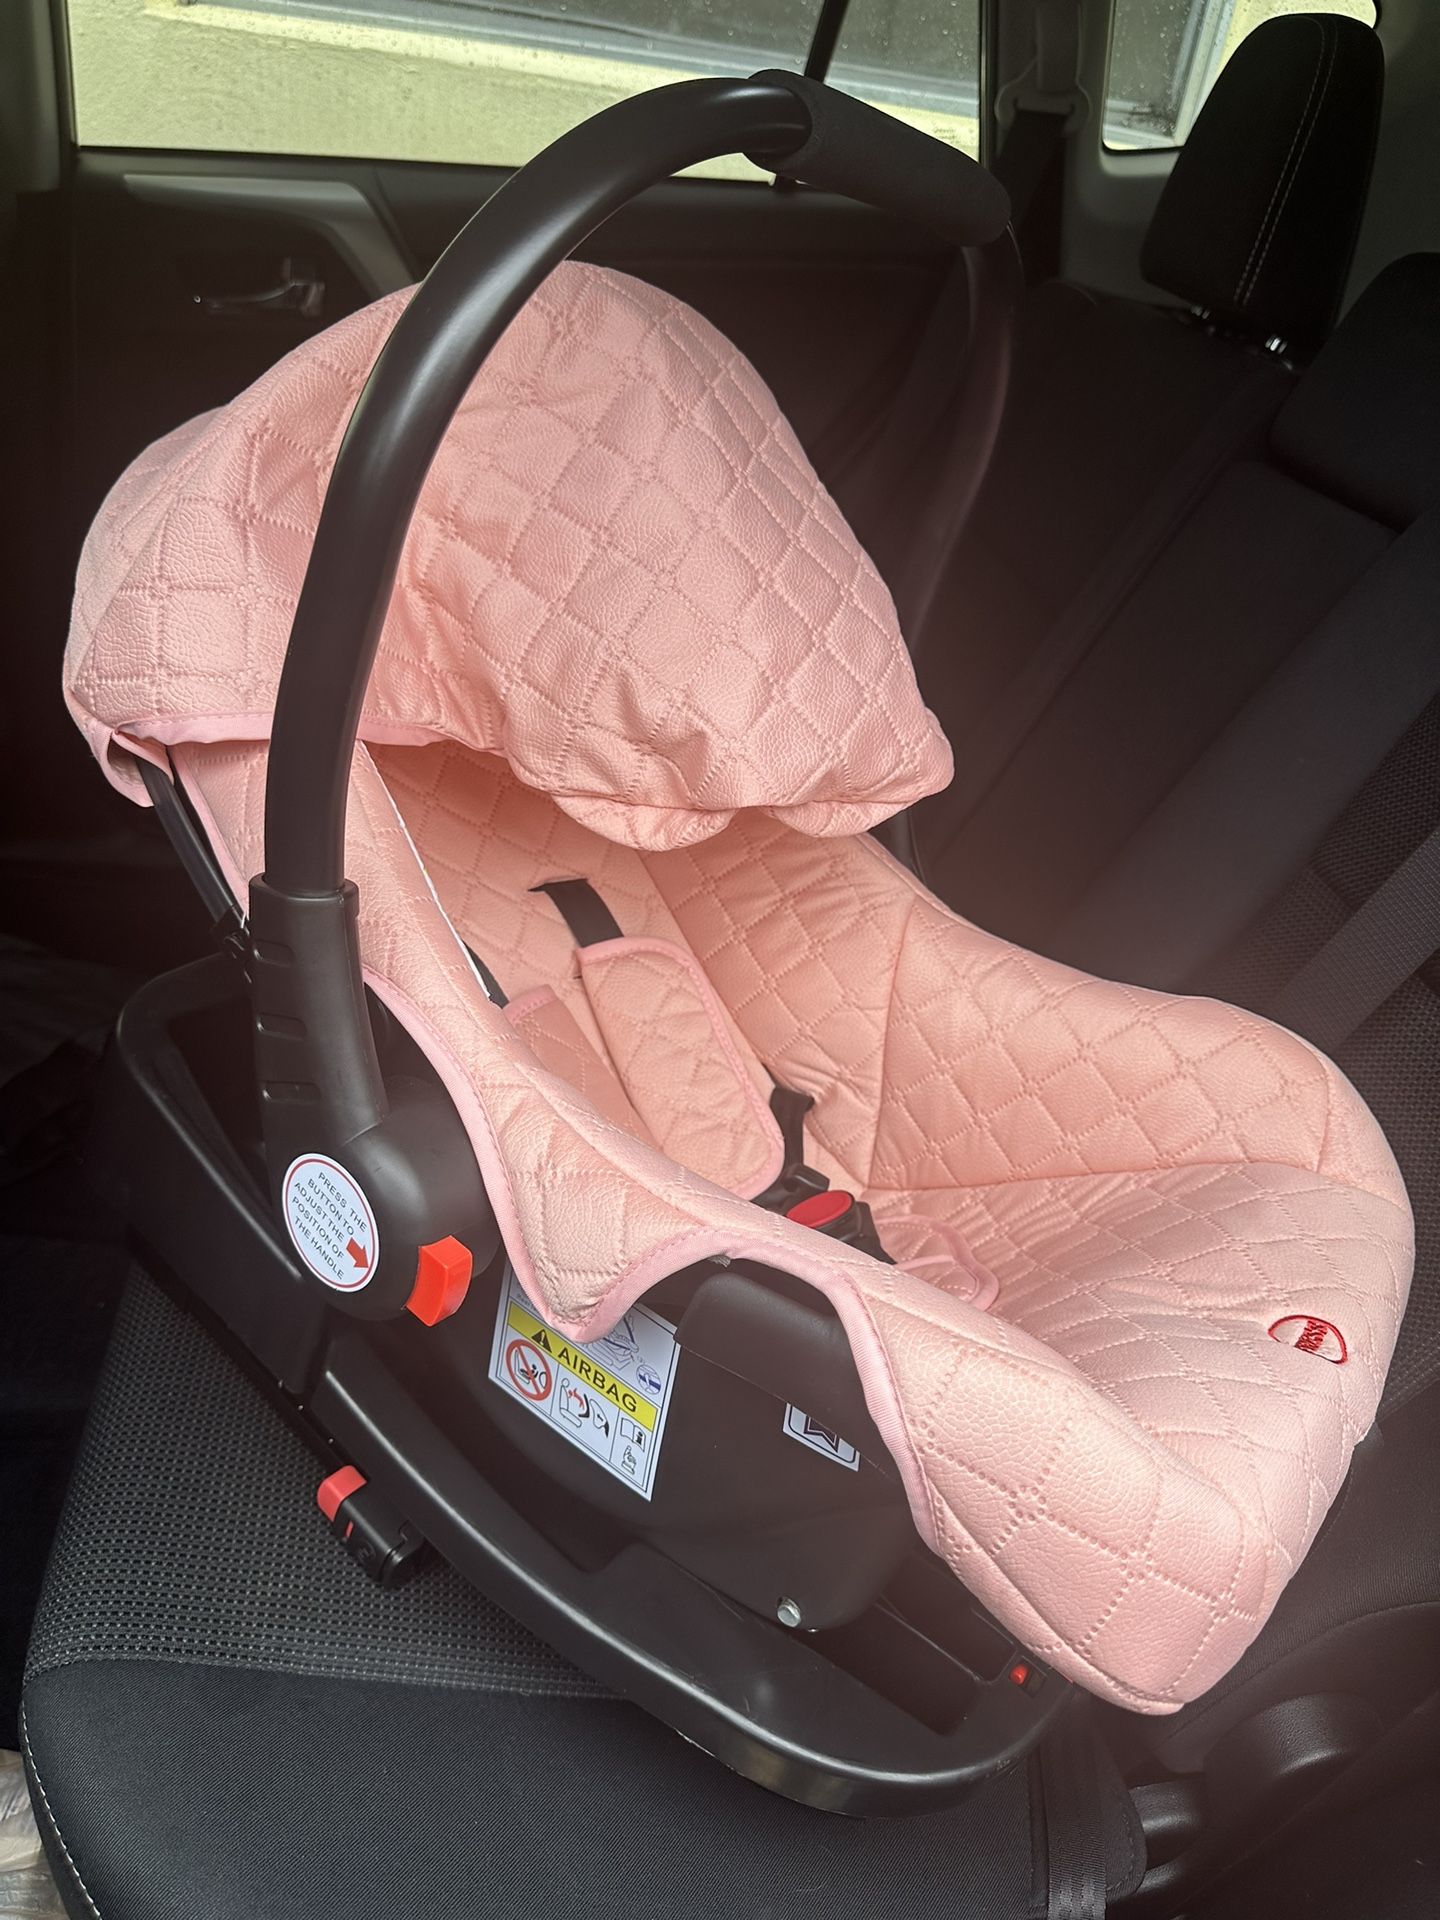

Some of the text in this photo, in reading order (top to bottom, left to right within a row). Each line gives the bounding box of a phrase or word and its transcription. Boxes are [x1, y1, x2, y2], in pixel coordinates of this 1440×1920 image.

[292, 1196, 345, 1259] POSITION OF
[294, 1182, 345, 1242] ADJUST THE
[308, 1178, 355, 1236] BUTTON TO
[318, 1172, 367, 1232] PRESS THE
[295, 1216, 345, 1280] THE HANDLE
[558, 1347, 637, 1412] AIRBAG
